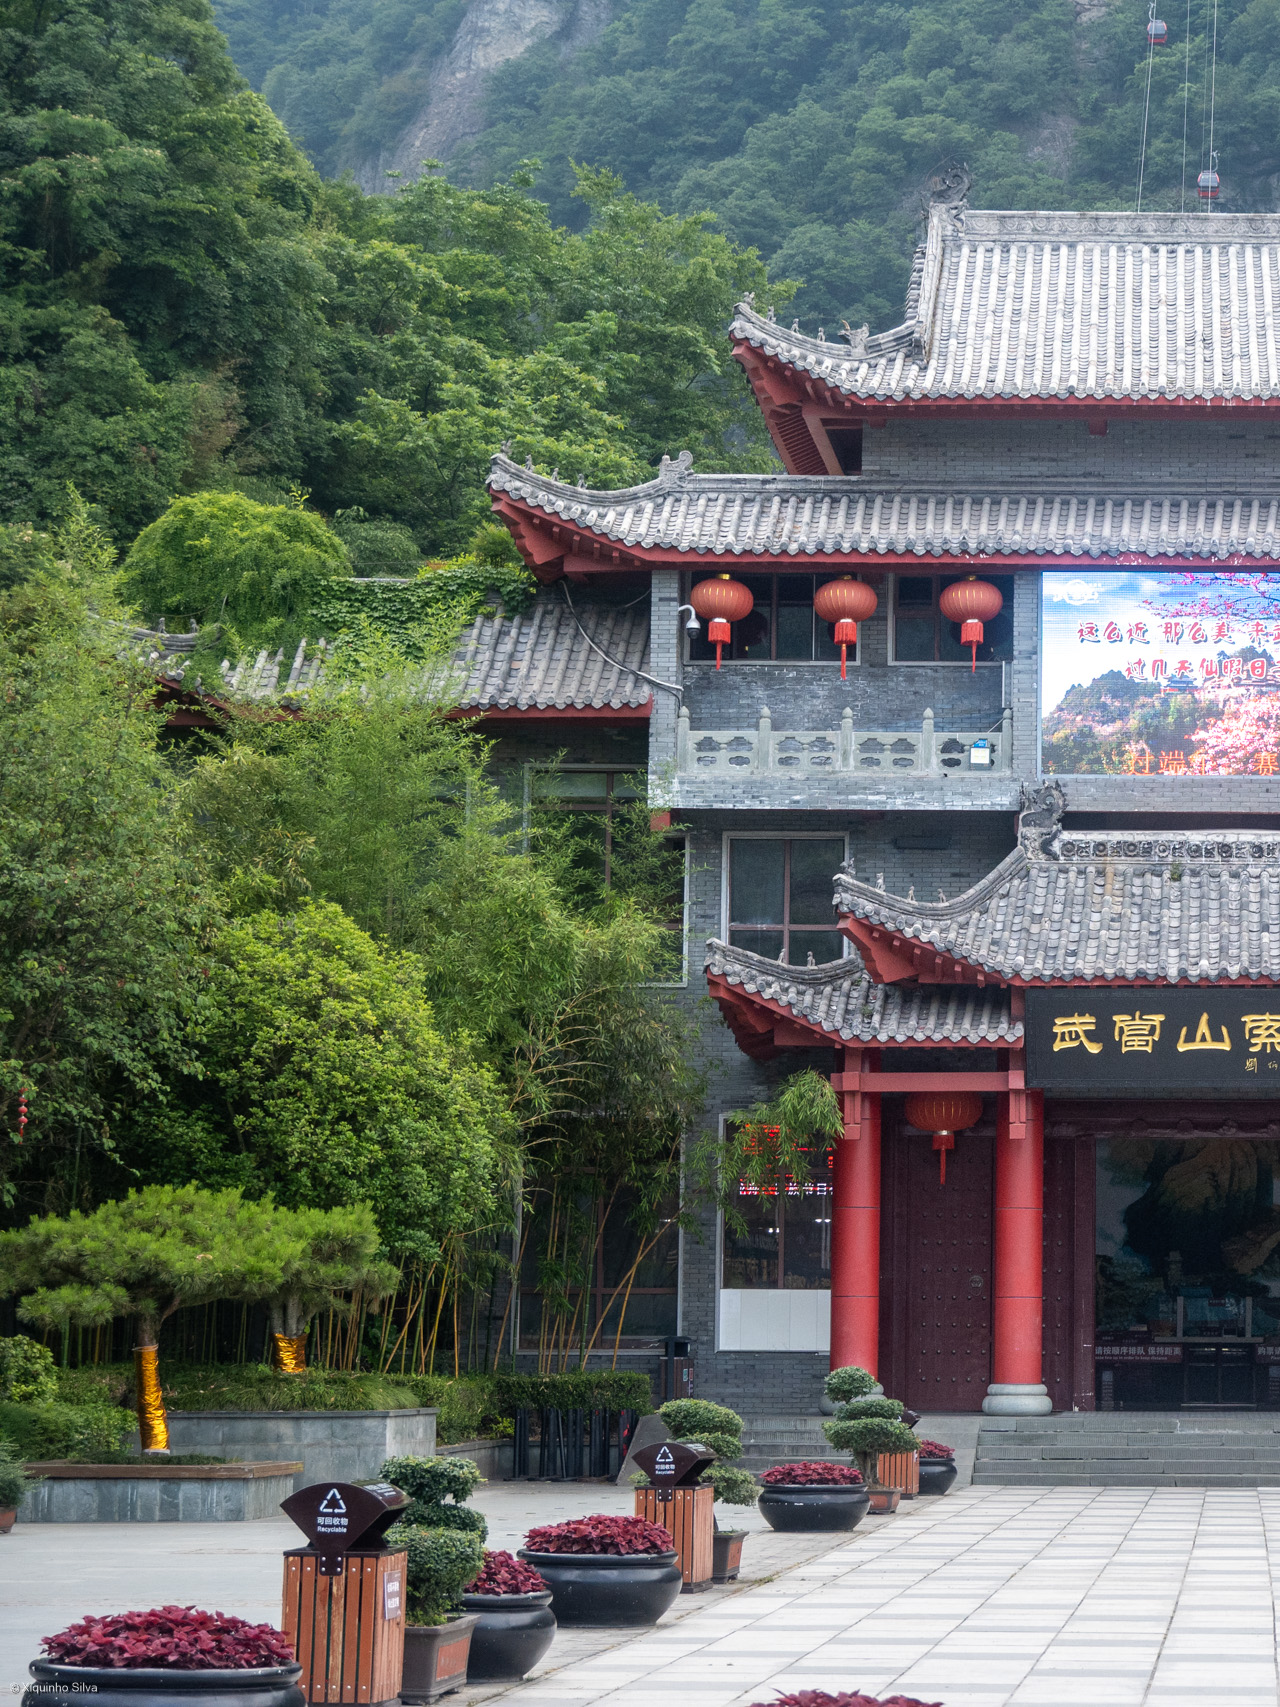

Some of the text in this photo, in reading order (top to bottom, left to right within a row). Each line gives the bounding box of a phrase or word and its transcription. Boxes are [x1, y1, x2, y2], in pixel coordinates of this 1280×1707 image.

[1077, 621, 1151, 644] 这么近
[1161, 621, 1236, 644] 那么美
[317, 1516, 348, 1526] 可回收物
